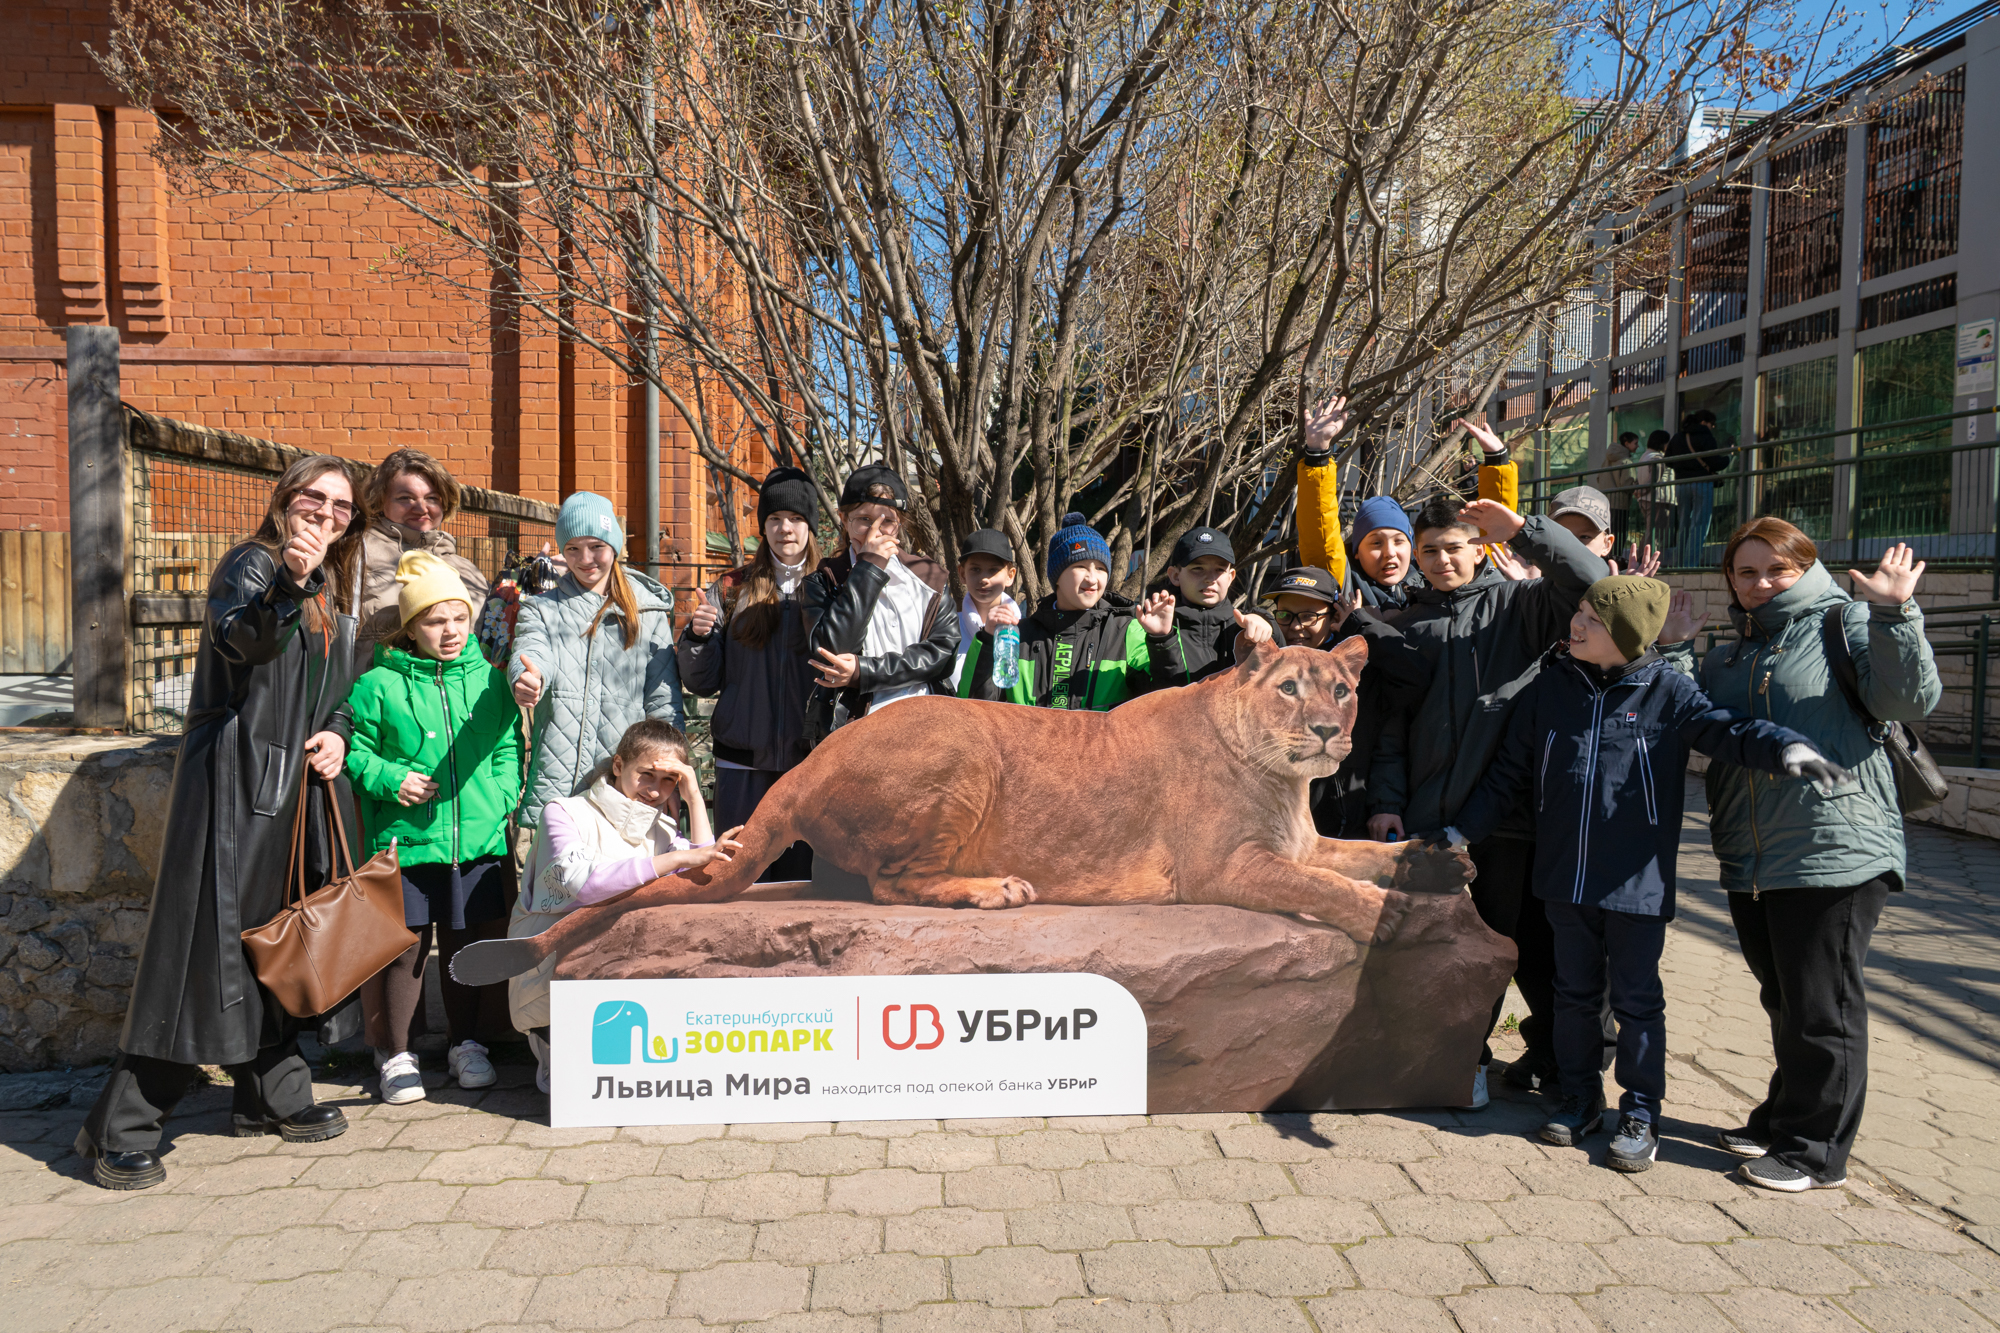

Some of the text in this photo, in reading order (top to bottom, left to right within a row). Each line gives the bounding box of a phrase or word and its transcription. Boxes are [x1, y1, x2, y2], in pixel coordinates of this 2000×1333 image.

[1051, 642, 1074, 709] AEPALEIS
[686, 1009, 833, 1028] Екатеринбургский
[956, 1008, 1098, 1044] УБРиР
[685, 1028, 834, 1054] ЗООПАРК
[592, 1073, 1098, 1101] Львица Мира находится под опекой банка УБРиР
